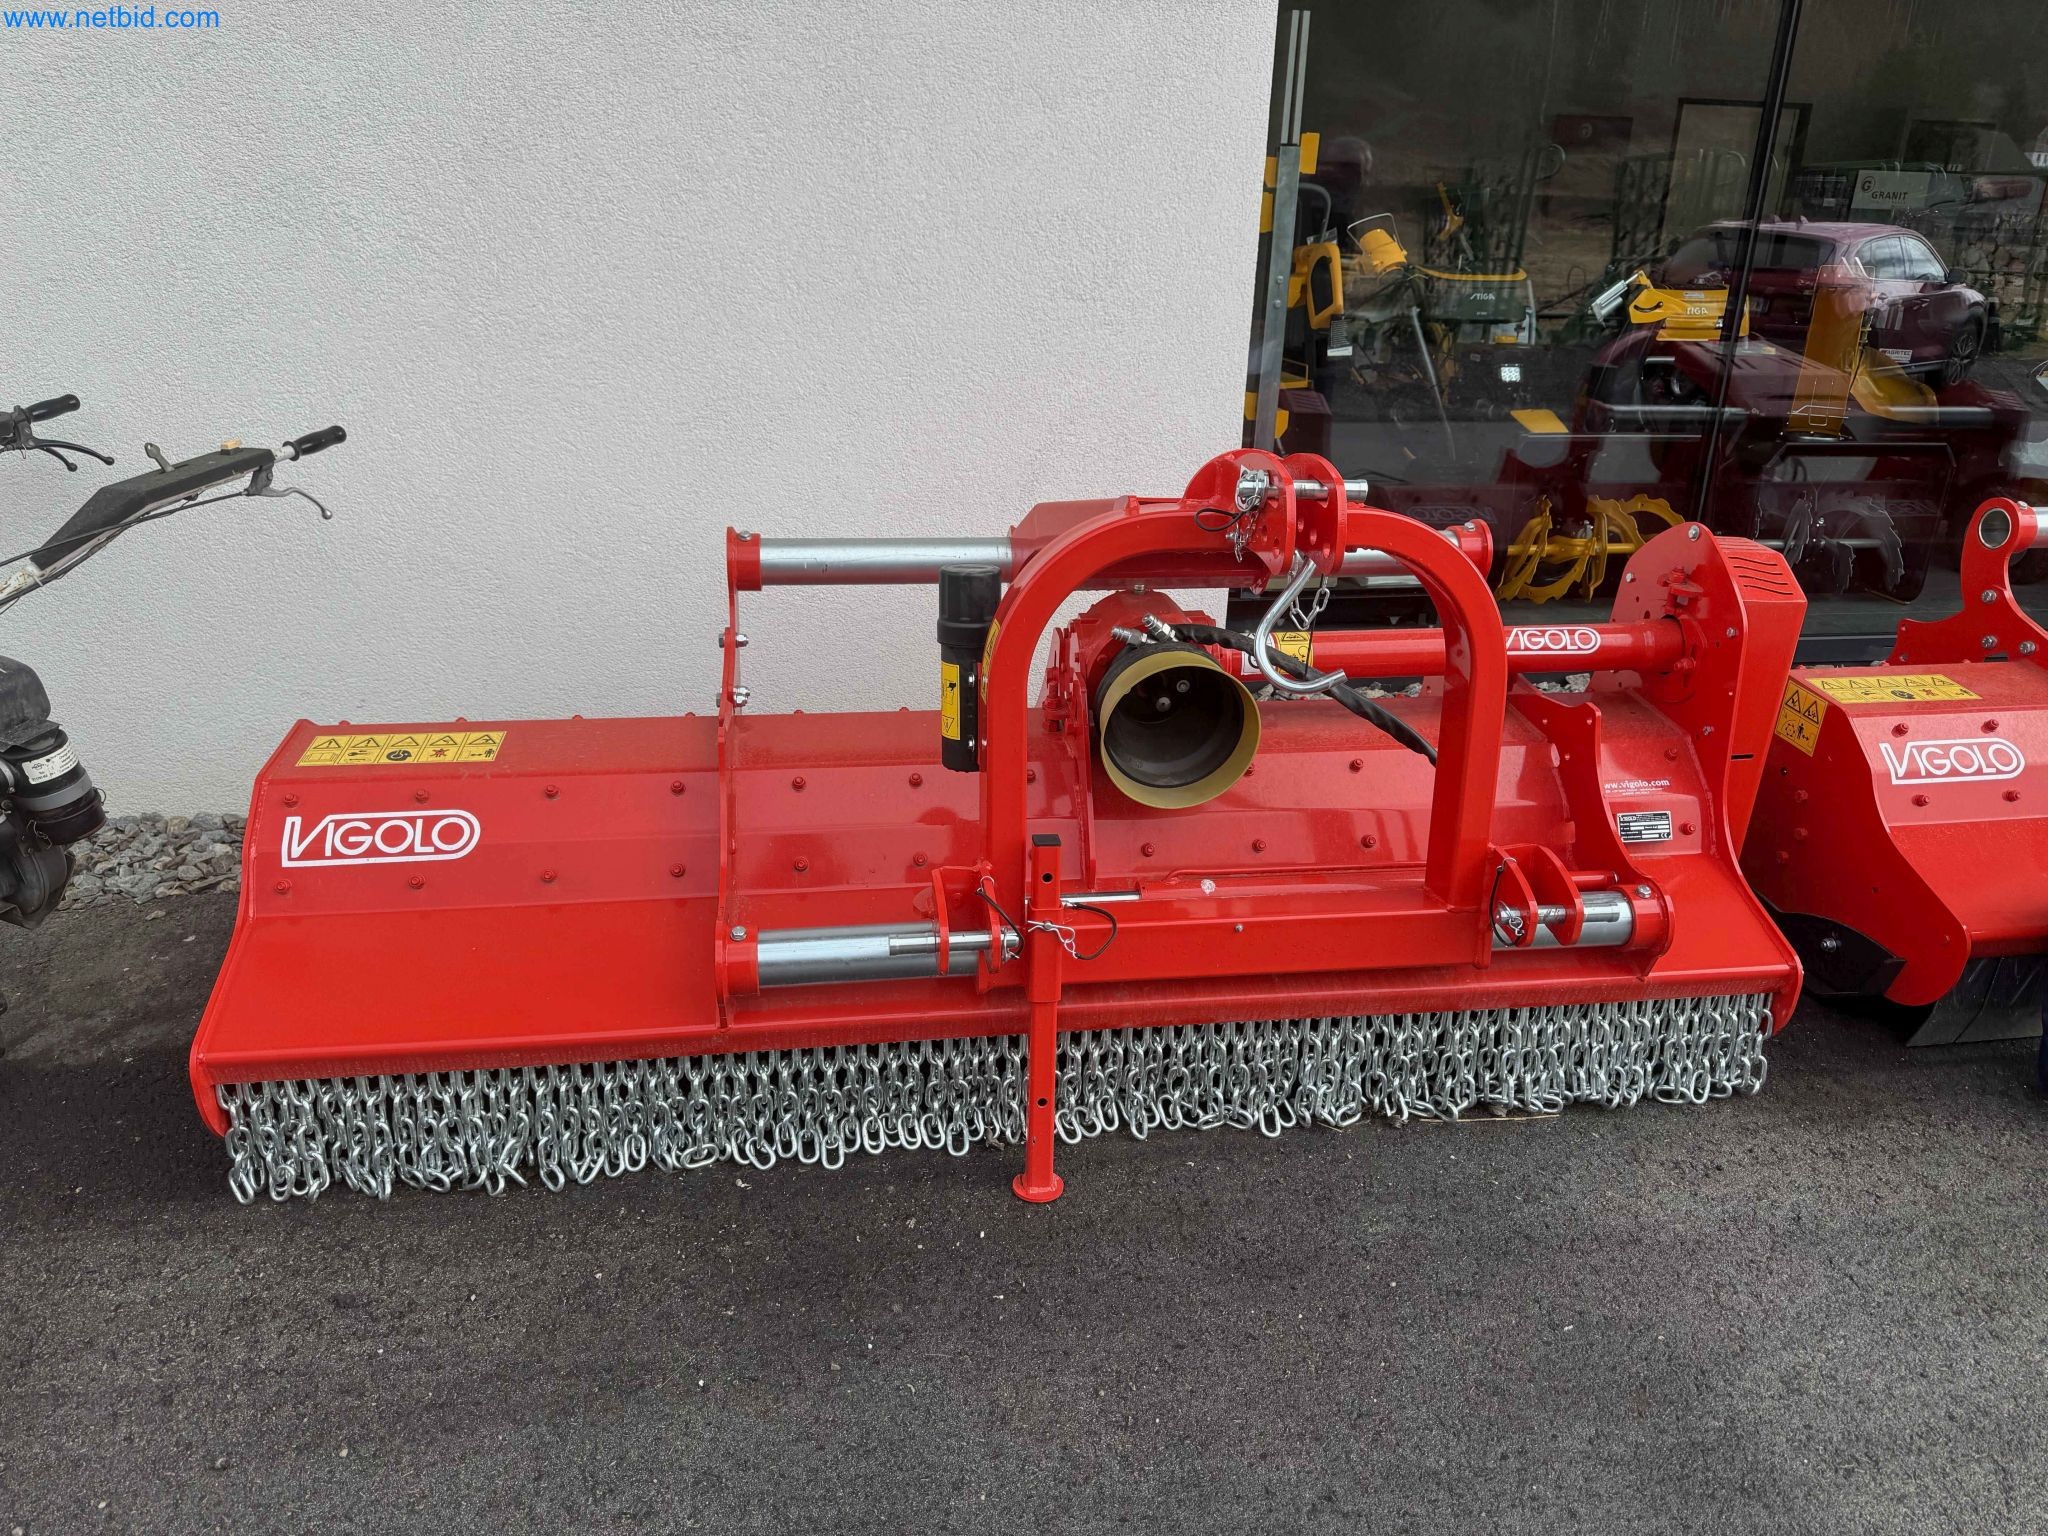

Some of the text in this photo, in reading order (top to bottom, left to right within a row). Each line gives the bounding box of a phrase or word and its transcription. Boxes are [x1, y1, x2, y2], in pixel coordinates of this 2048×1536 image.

[1871, 191, 1908, 200] GRANIT
[1470, 292, 1495, 300] STIGA
[1686, 307, 1708, 315] TIGA
[1880, 741, 2021, 779] VIGOLO
[282, 812, 474, 861] VIGOLO
